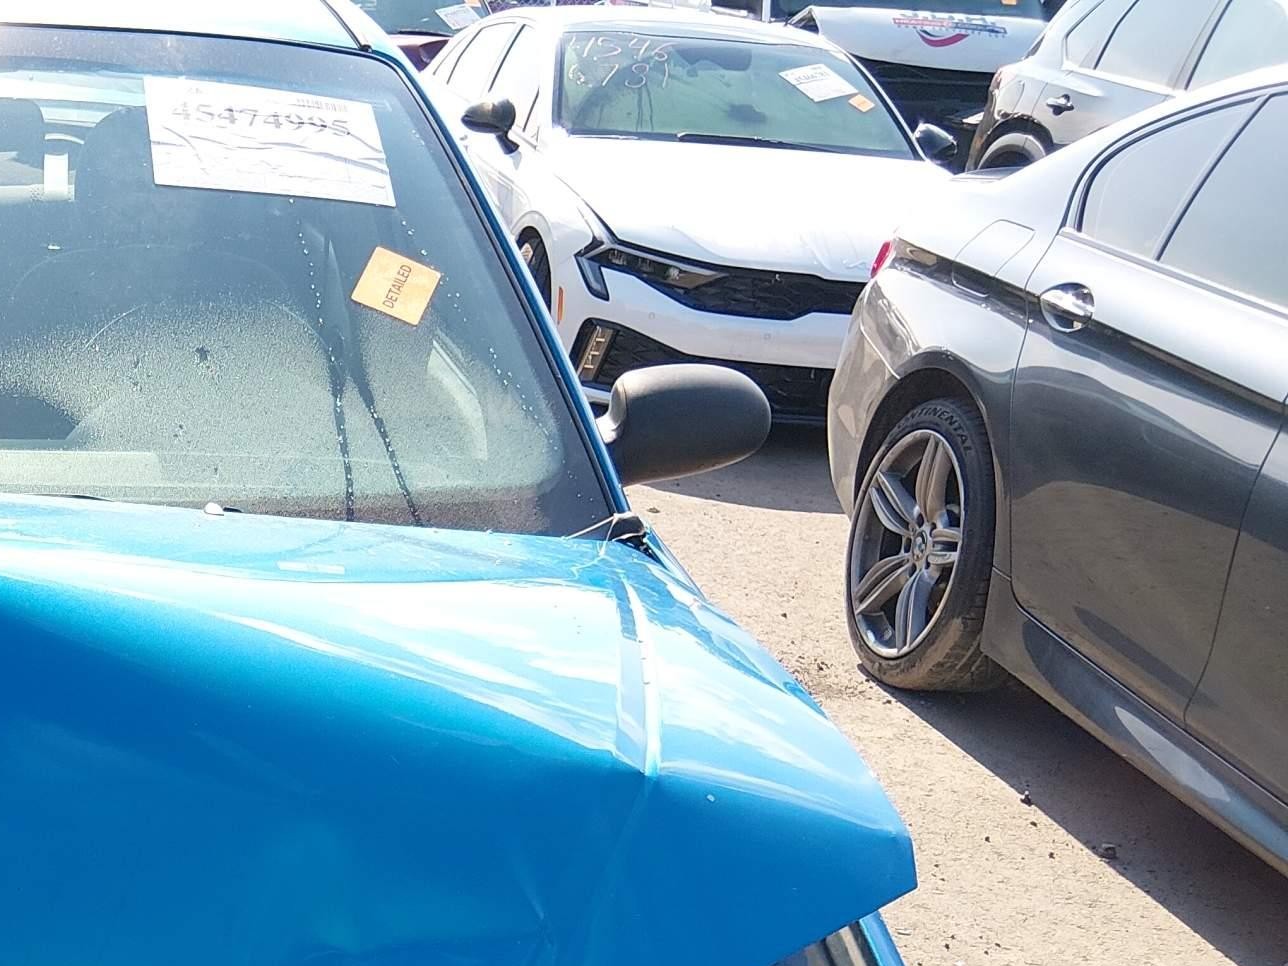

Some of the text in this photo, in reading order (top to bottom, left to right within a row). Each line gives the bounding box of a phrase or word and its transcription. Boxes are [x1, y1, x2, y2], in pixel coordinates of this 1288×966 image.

[171, 101, 350, 136] 45474995
[382, 264, 412, 309] DETAILED
[897, 406, 973, 457] ONTINENTAL
